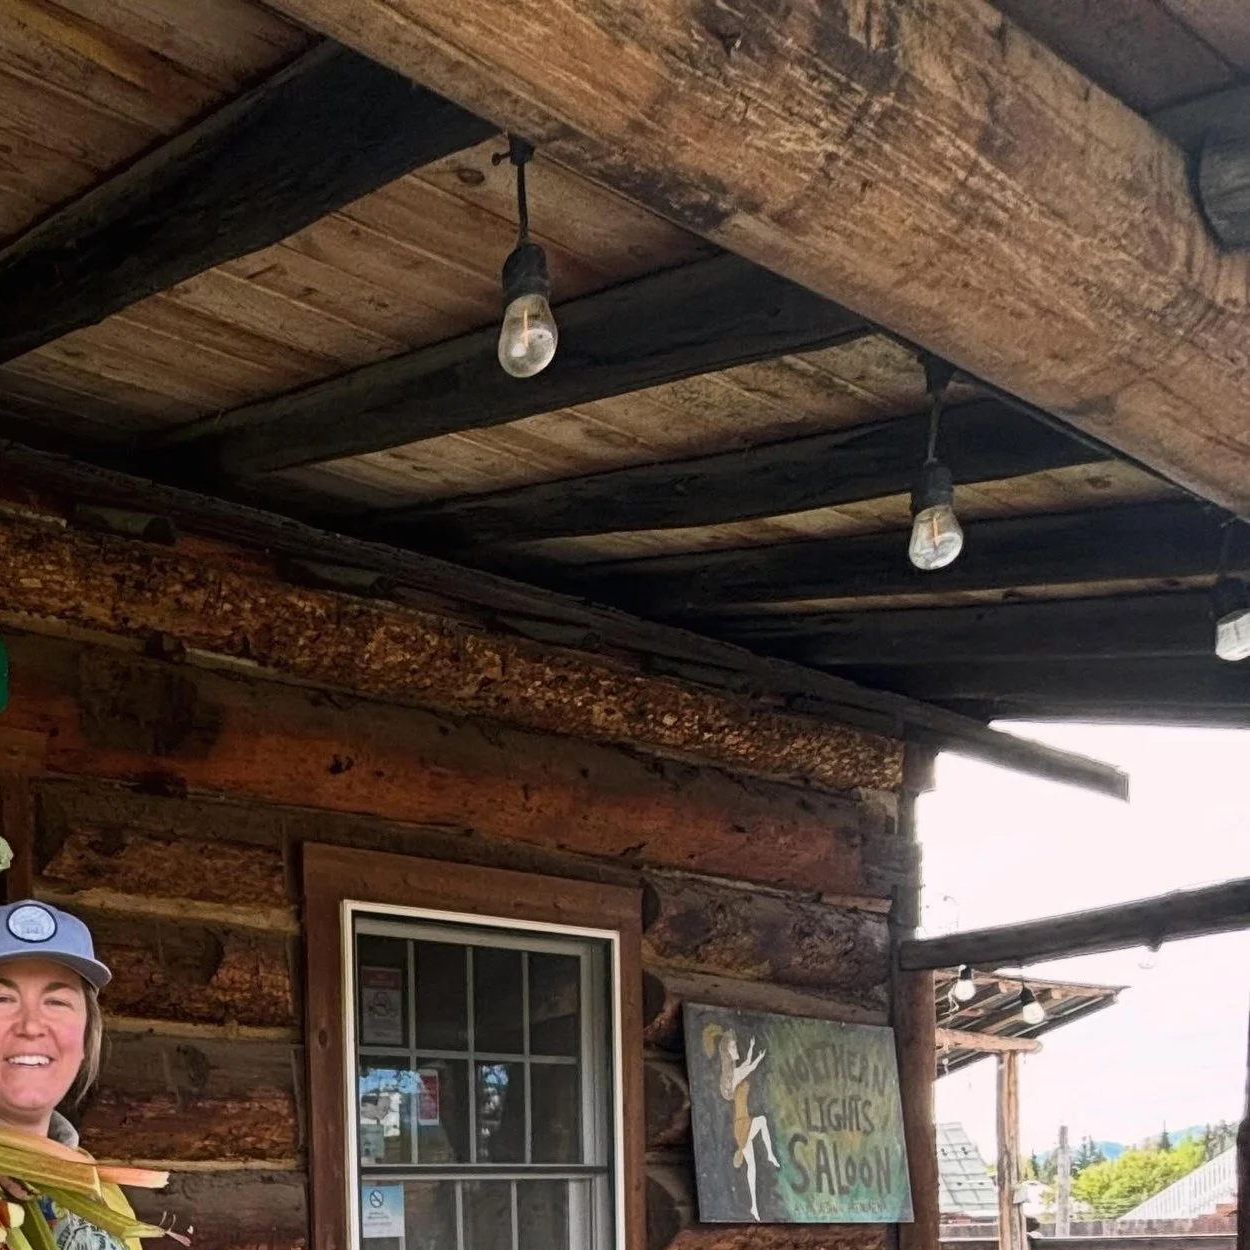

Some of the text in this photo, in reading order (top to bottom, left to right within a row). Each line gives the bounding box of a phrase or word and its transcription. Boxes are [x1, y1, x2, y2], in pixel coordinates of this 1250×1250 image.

[778, 1042, 888, 1097] NORTHERN
[804, 1095, 875, 1136] LIGHTS
[787, 1132, 892, 1196] SALOON
